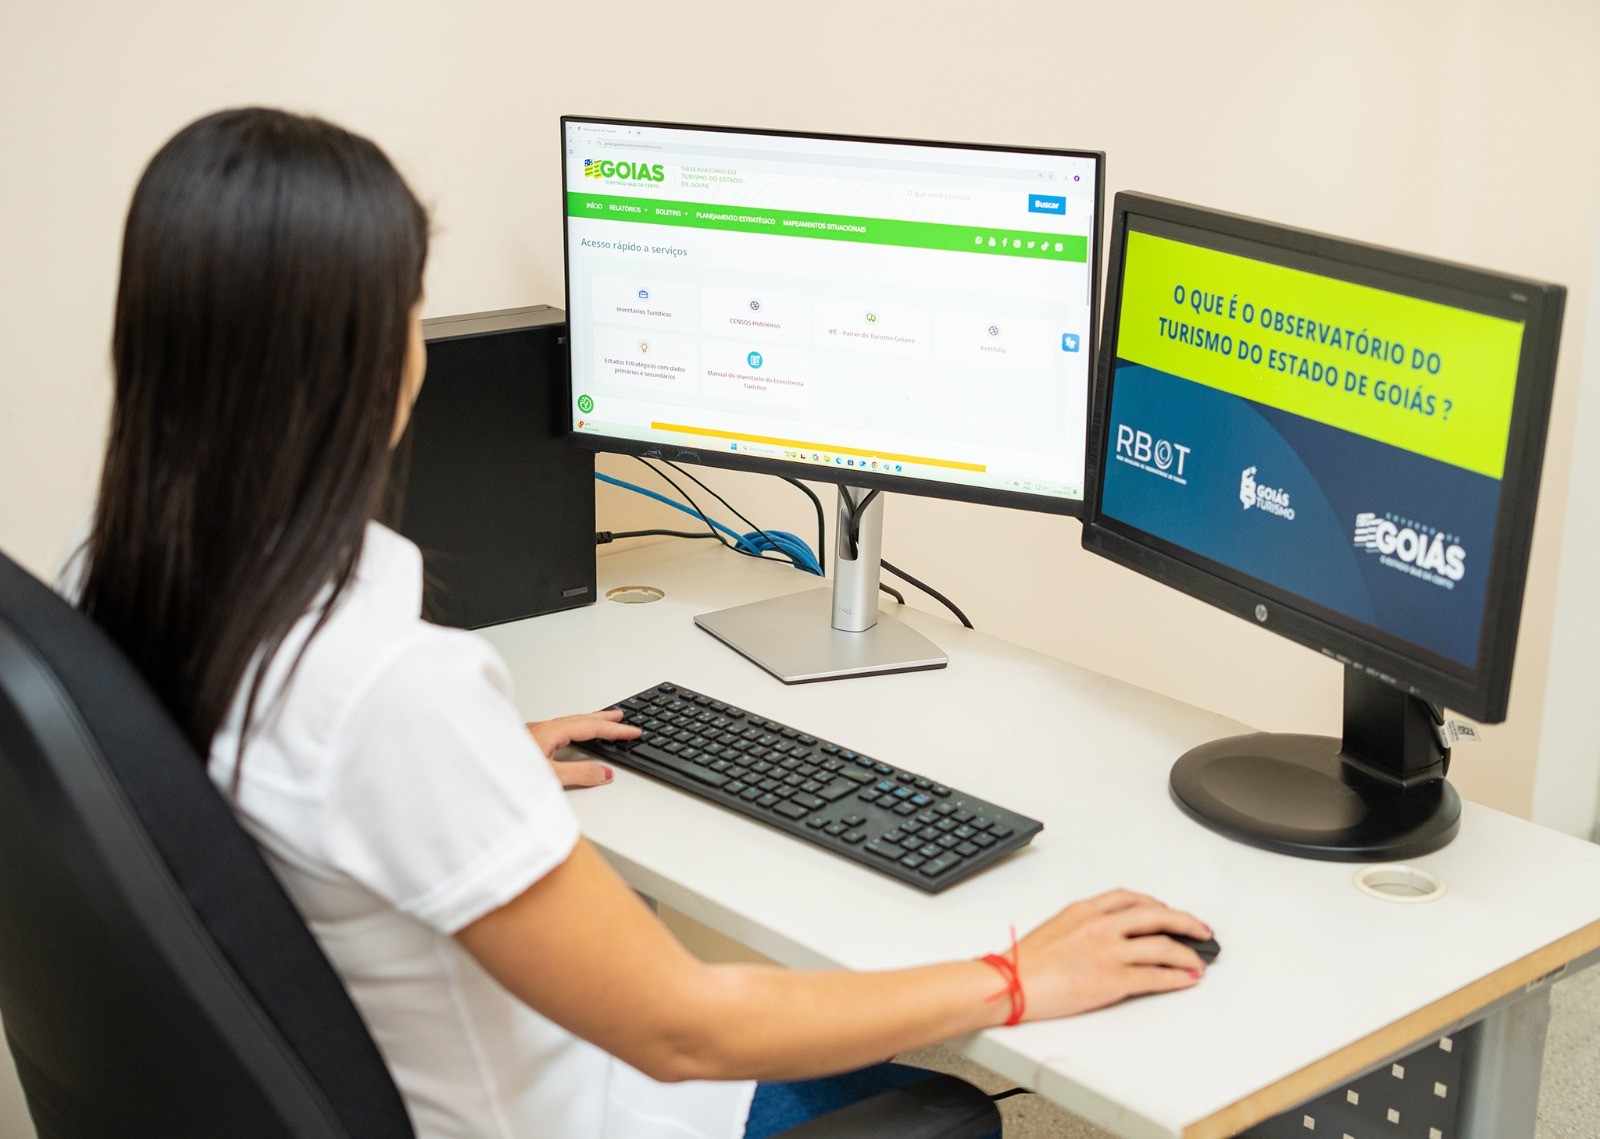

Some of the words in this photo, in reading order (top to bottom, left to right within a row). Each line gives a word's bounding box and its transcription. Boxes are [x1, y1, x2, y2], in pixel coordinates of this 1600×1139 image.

[1035, 200, 1060, 209] Buscar
[609, 204, 641, 213] RELATÓRIOS
[655, 208, 682, 217] BOLETINS
[696, 212, 738, 222] PLANEJAMENTO
[739, 215, 776, 225] ESTRATÉGICO
[783, 220, 826, 229] MAPEAMENTOS
[826, 224, 867, 233] SITUACIONAIS
[581, 238, 611, 249] Acesso
[613, 241, 642, 253] rápido
[643, 245, 649, 253] a
[651, 246, 688, 257] serviços
[752, 320, 781, 329] Hoteleiros
[1174, 284, 1185, 305] O
[1190, 289, 1224, 315] QUE
[1229, 294, 1238, 319] É
[1242, 303, 1254, 324] O
[1260, 308, 1404, 364] OBSERVATÓRIO
[1411, 348, 1441, 375] DO
[604, 357, 625, 366] Estudos
[669, 365, 685, 373] dados
[707, 370, 728, 378] Manual
[1159, 317, 1232, 356] TURISMO
[1238, 340, 1263, 364] DO
[1268, 349, 1338, 387] ESTADO
[1344, 371, 1368, 396] DE
[1374, 380, 1436, 416] GOIÁS
[1443, 399, 1453, 421] ?
[1116, 424, 1191, 476] RBOT
[1256, 485, 1290, 507] GOIÁS
[1256, 498, 1295, 521] TURISMO
[1375, 520, 1466, 581] GOIÁS
